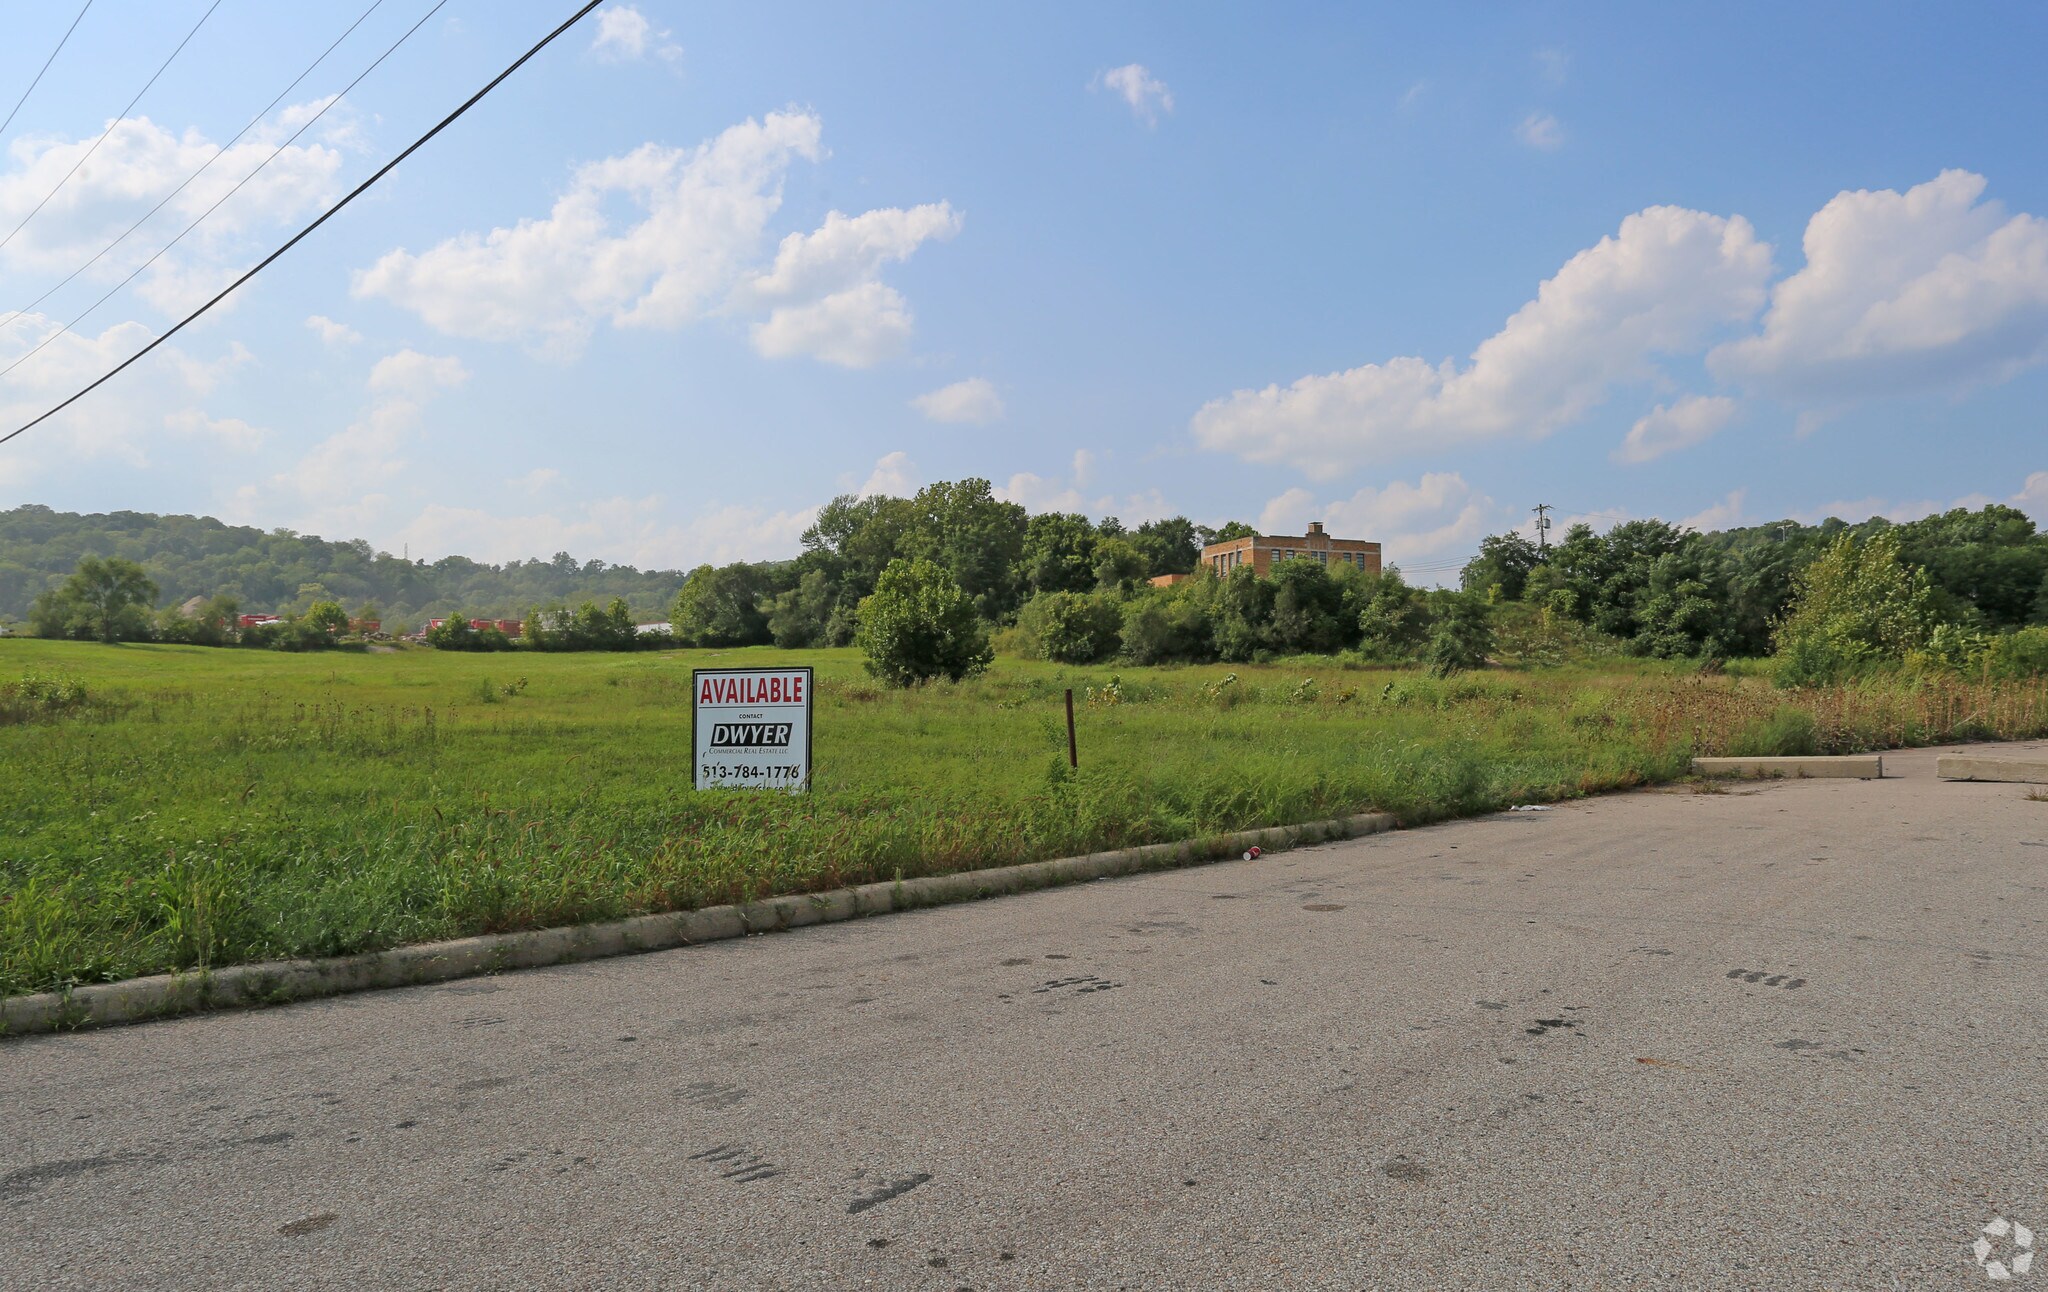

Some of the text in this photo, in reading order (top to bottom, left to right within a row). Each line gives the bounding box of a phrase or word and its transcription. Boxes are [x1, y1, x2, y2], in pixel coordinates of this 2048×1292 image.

[700, 677, 803, 704] AVAILABLE
[713, 725, 789, 744] DWYER
[703, 765, 800, 779] 513-784-1776
